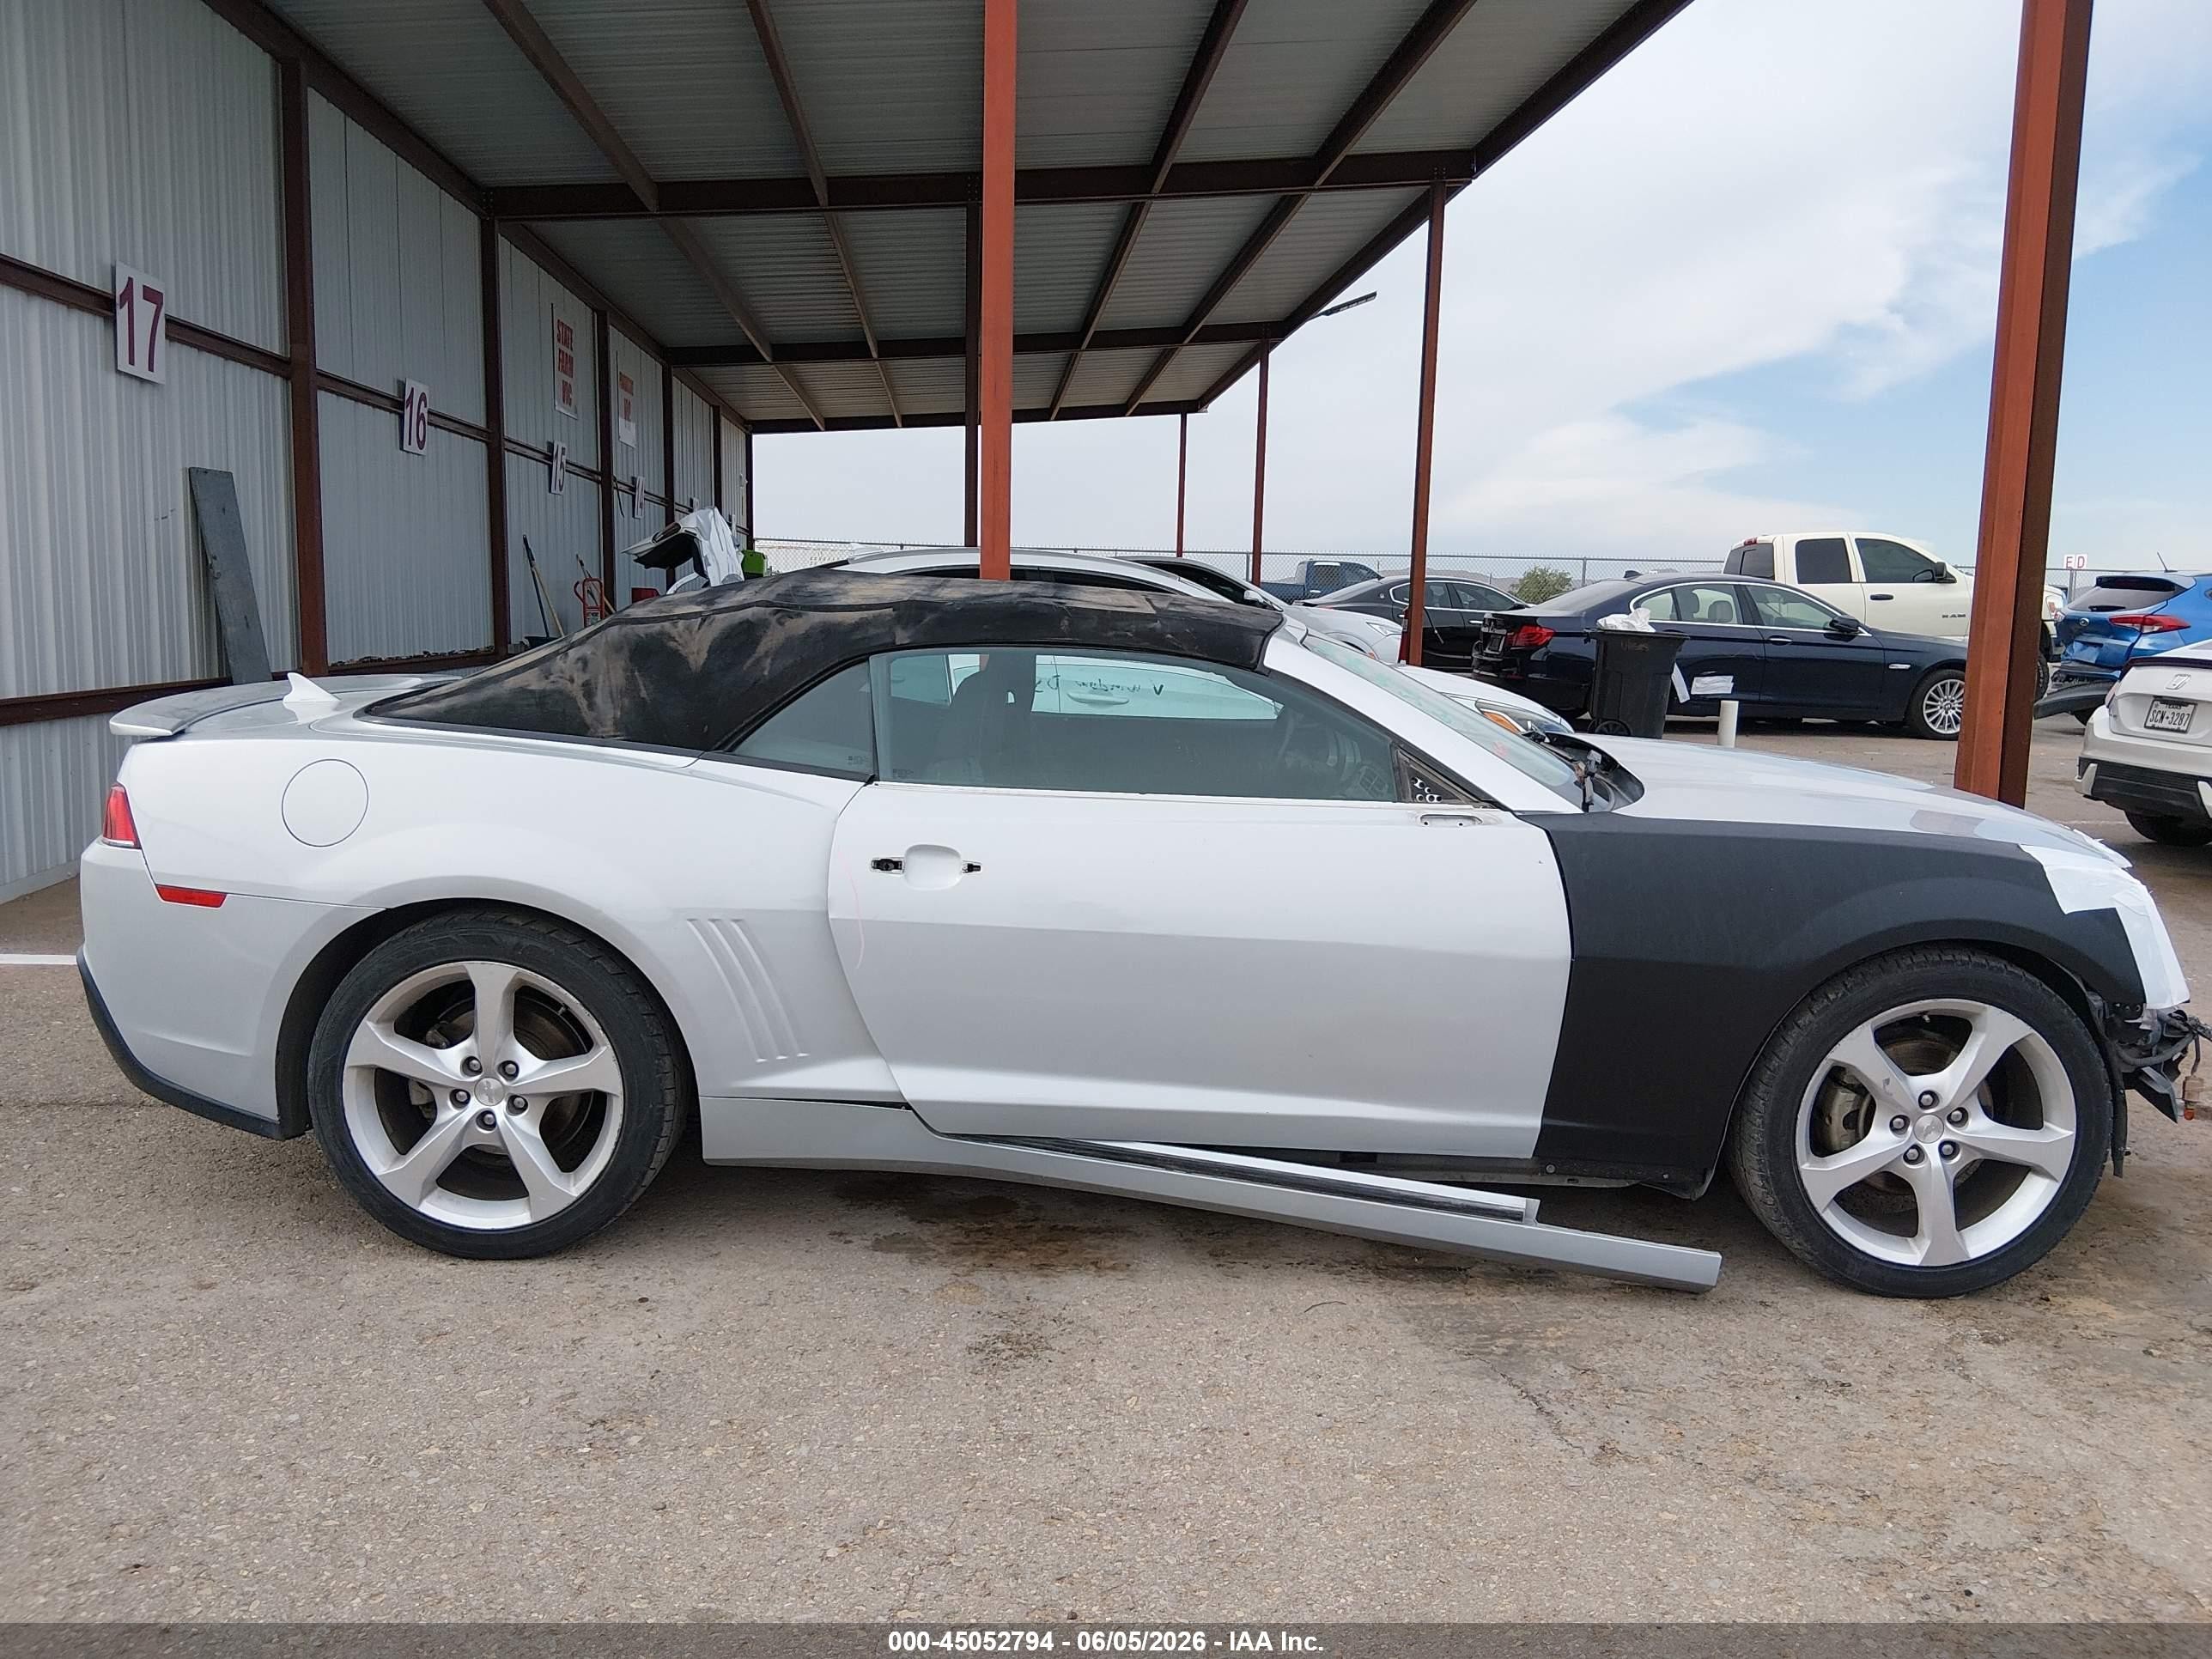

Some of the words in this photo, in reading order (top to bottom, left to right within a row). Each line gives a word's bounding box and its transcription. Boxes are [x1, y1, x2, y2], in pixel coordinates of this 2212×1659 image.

[118, 276, 164, 373] 17
[556, 319, 574, 351] STATE
[405, 386, 428, 451] 16
[554, 443, 566, 492] 15
